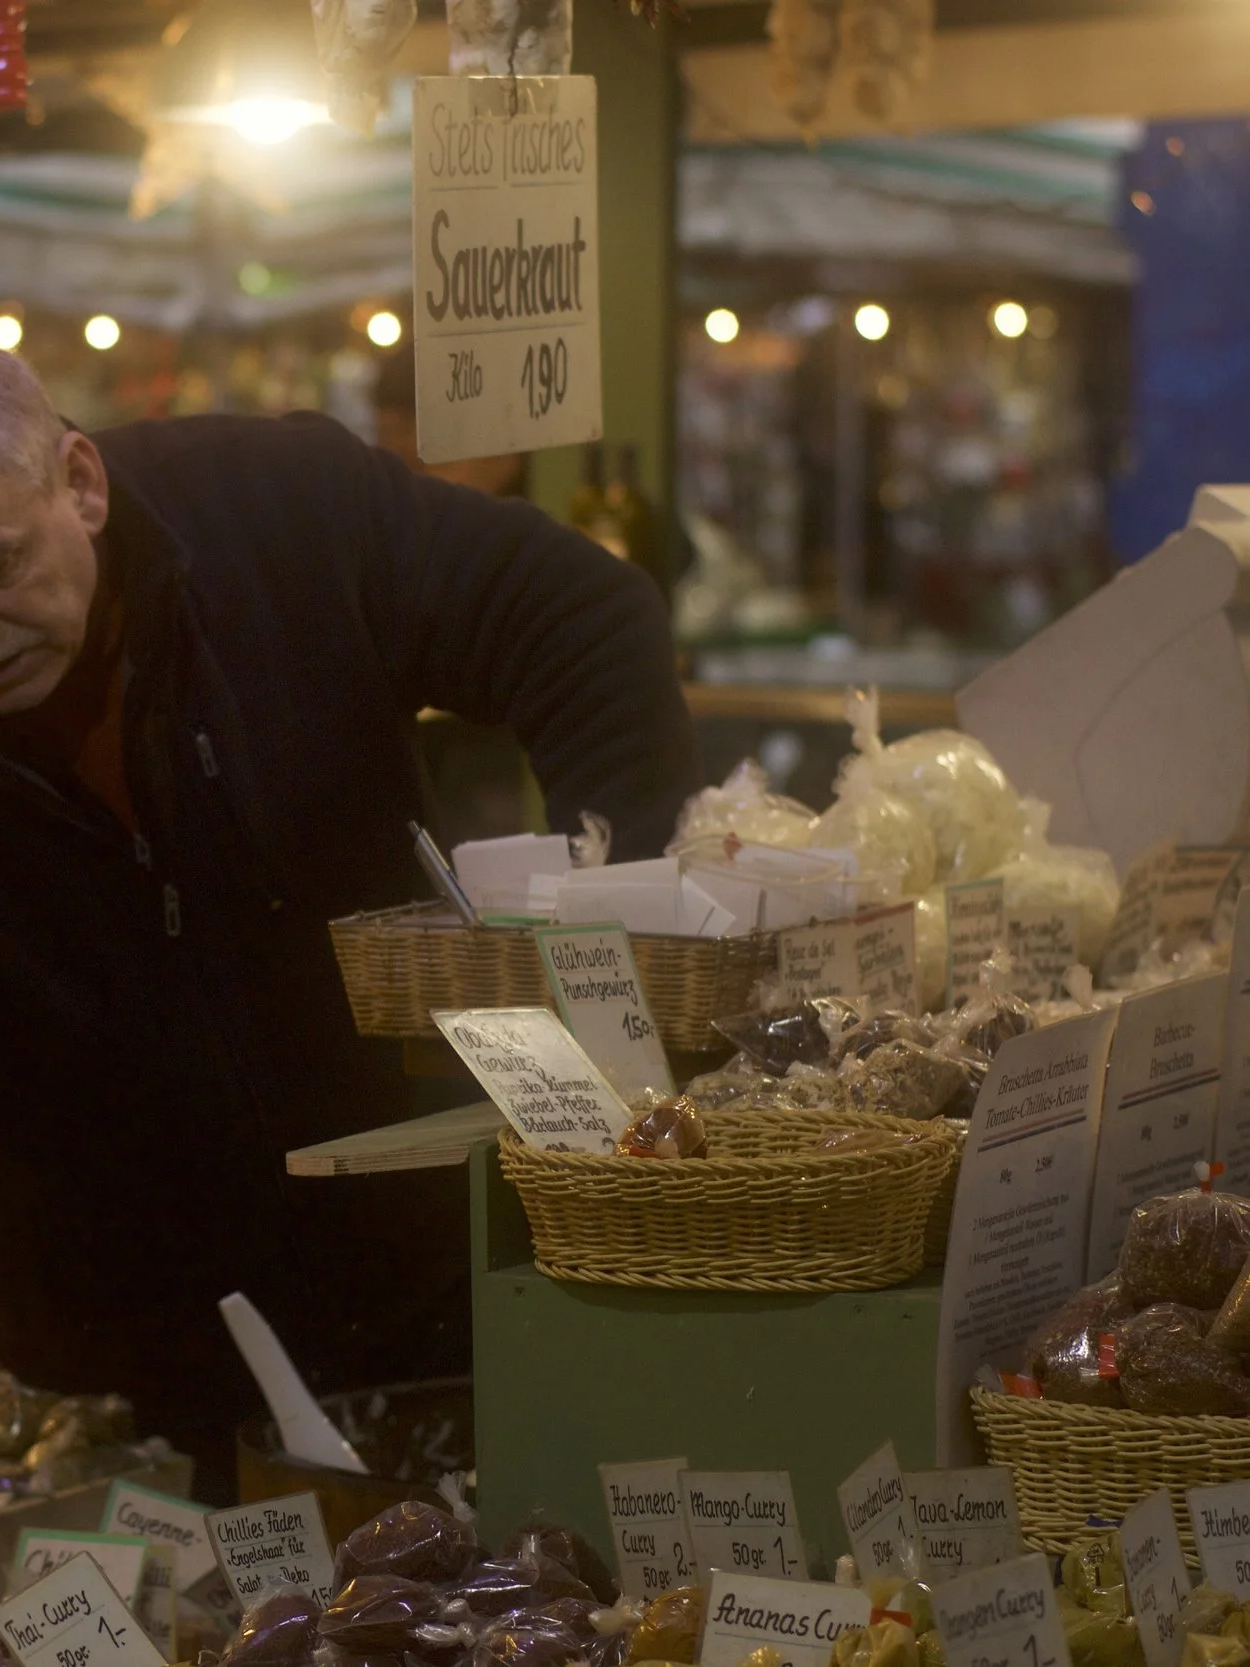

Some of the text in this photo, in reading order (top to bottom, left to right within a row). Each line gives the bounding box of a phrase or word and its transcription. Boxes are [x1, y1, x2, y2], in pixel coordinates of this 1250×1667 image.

[428, 101, 586, 182] Stets frisches
[426, 208, 587, 322] Sauerkraut
[446, 349, 484, 403] Kilo
[550, 937, 622, 971] Glühwein-
[560, 972, 639, 1007] Punschgewürz
[217, 1508, 305, 1543] Chillies Fäden
[689, 1488, 787, 1527] Mango-Curry
[288, 1535, 306, 1557] für
[621, 1529, 656, 1557] Curry
[922, 1535, 963, 1566] urry
[4, 1589, 92, 1651] Thai-Curry
[712, 1592, 810, 1637] Ananas
